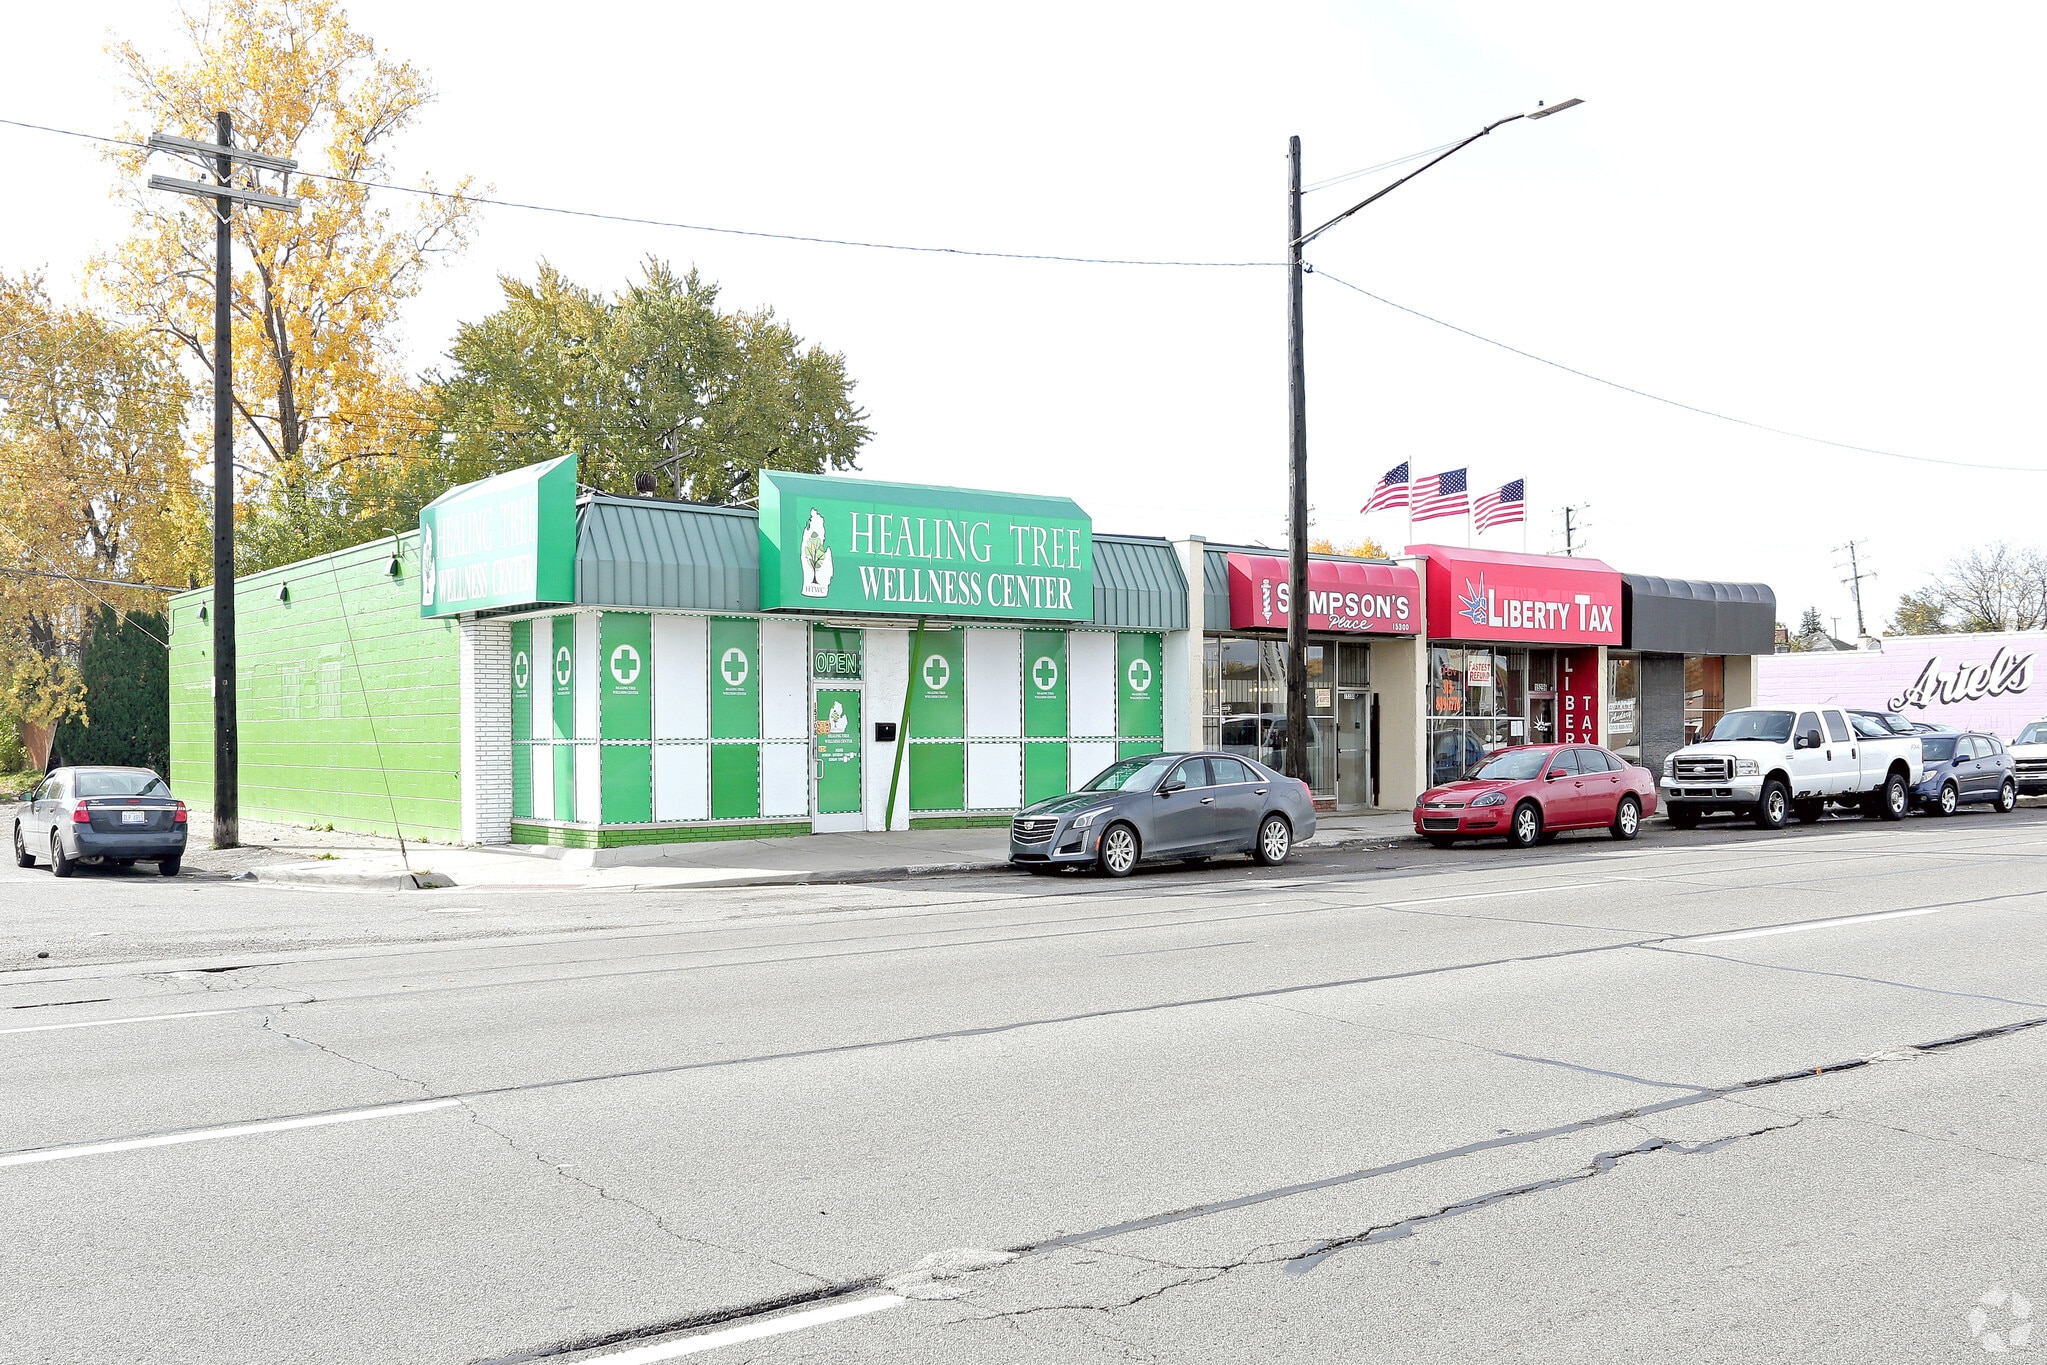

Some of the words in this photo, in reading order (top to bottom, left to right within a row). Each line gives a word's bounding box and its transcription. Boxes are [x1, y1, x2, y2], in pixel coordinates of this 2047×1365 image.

[437, 506, 494, 560] HEALING
[500, 495, 537, 549] TREE
[849, 511, 993, 565] HEALING
[1009, 522, 1082, 572] TREE
[438, 561, 489, 604] WELLNESS
[492, 553, 534, 597] CENTER
[805, 585, 826, 594] HTWC
[858, 565, 983, 606] WELLNESS
[987, 572, 1074, 609] CENTER
[1276, 581, 1410, 620] SMPSON'S
[1328, 614, 1374, 630] Place
[1488, 588, 1571, 631] LIBERTY
[1392, 622, 1410, 631] 15300
[815, 652, 857, 674] OPEN
[1468, 661, 1491, 672] FASTEST
[1887, 645, 2039, 713] Ariel's
[1581, 695, 1593, 745] TAX
